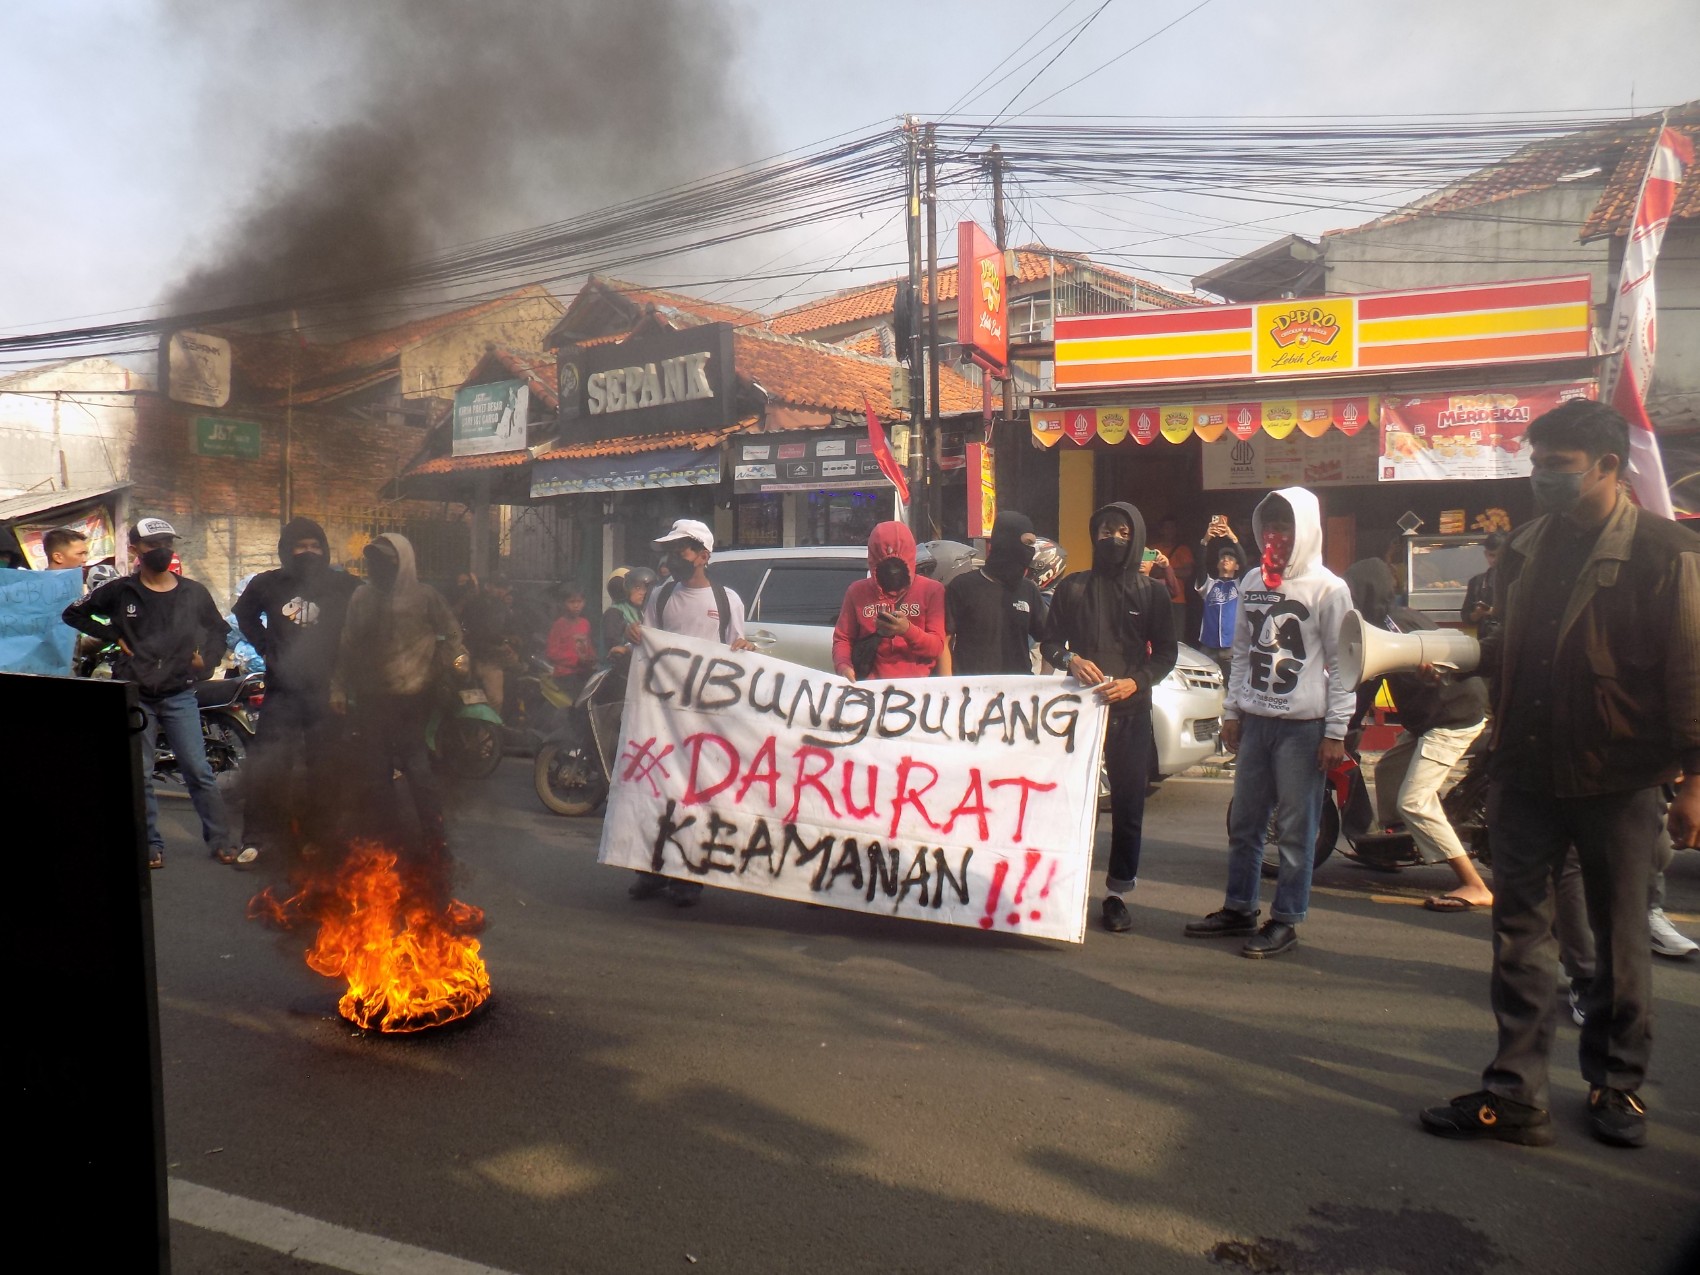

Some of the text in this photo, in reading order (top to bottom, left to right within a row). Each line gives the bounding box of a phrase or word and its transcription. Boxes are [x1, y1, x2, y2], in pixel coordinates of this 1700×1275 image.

[1271, 350, 1338, 368] Lebih Enak
[587, 351, 714, 415] SEPANK
[1438, 406, 1530, 428] MERDEKA!
[649, 468, 719, 480] SANDAL
[1250, 593, 1281, 603] CAVES
